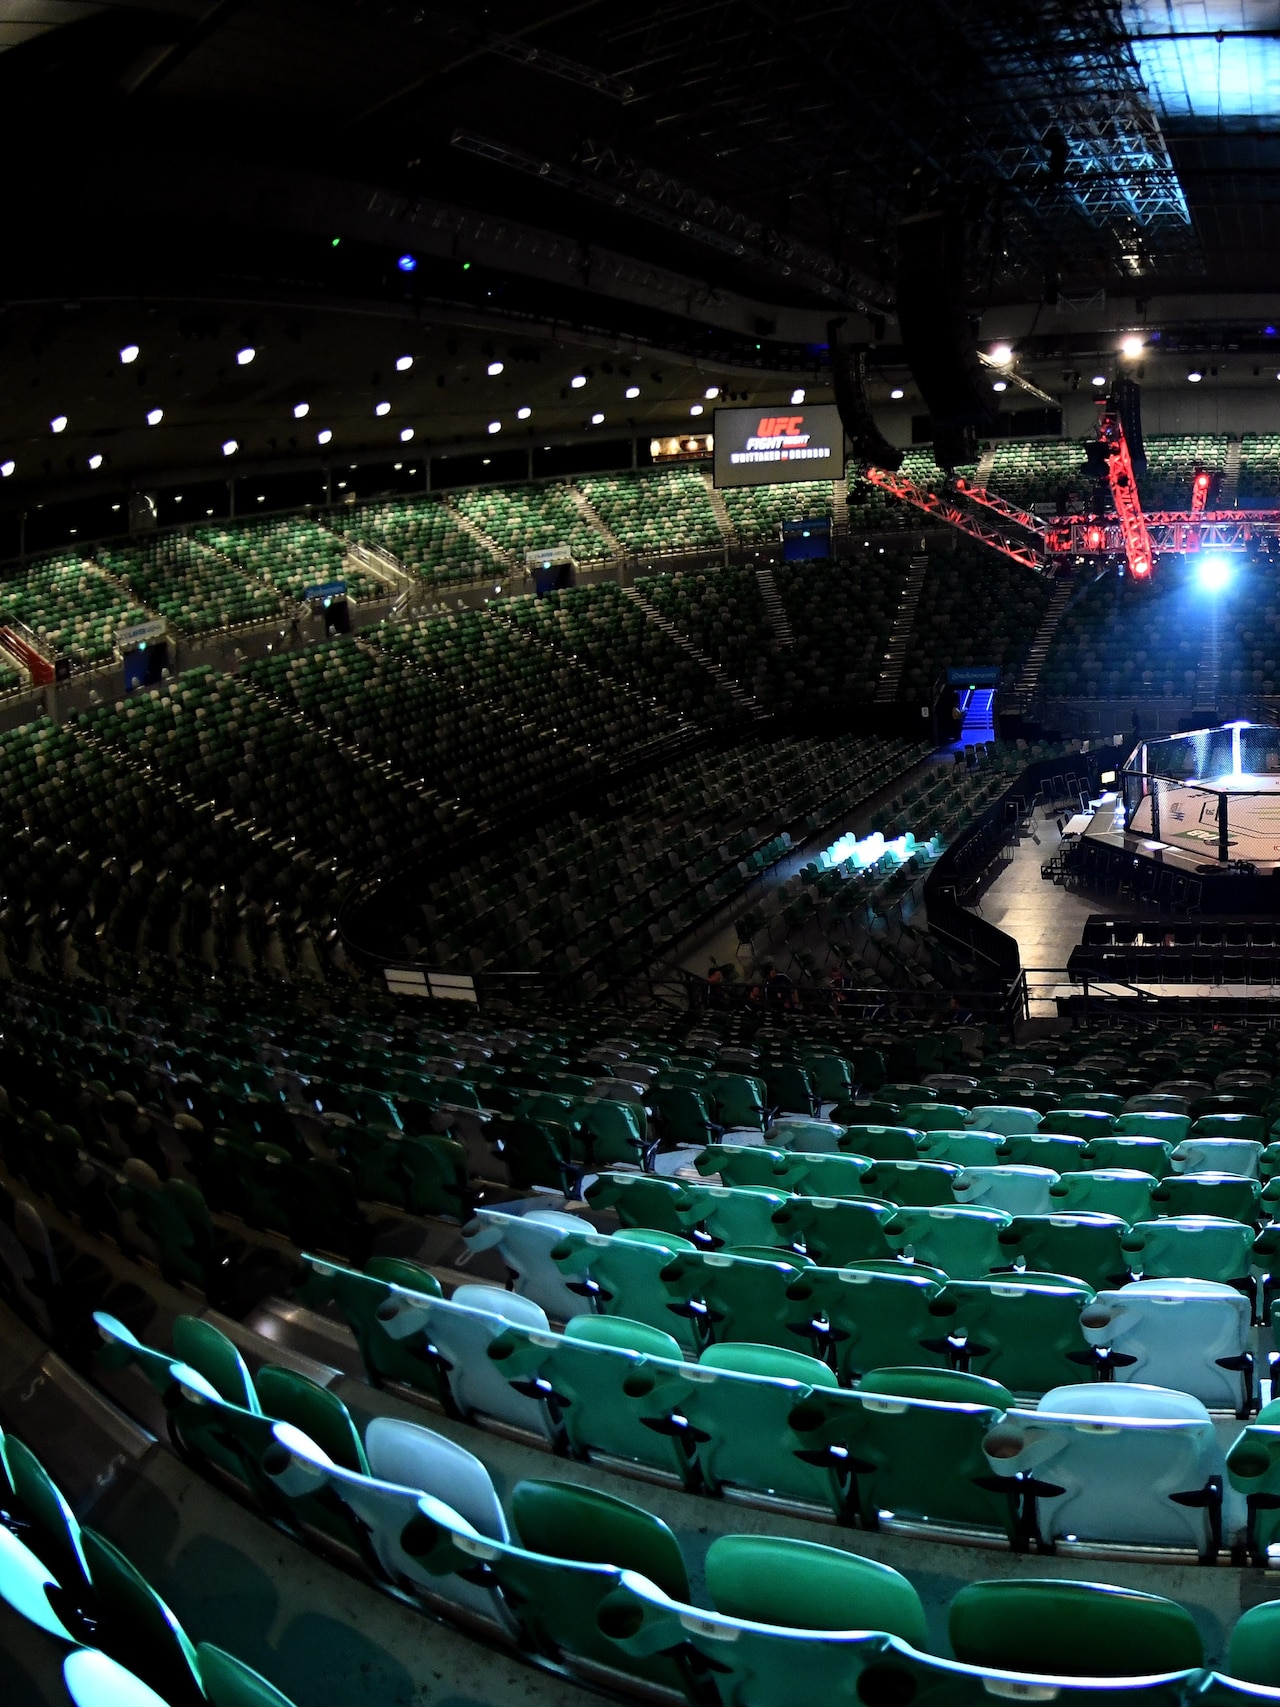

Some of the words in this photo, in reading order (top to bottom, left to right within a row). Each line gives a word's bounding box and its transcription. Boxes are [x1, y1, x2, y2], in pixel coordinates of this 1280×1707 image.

[757, 416, 804, 438] UFC
[747, 436, 784, 450] FIGHT
[731, 450, 780, 464] WHITTAKER
